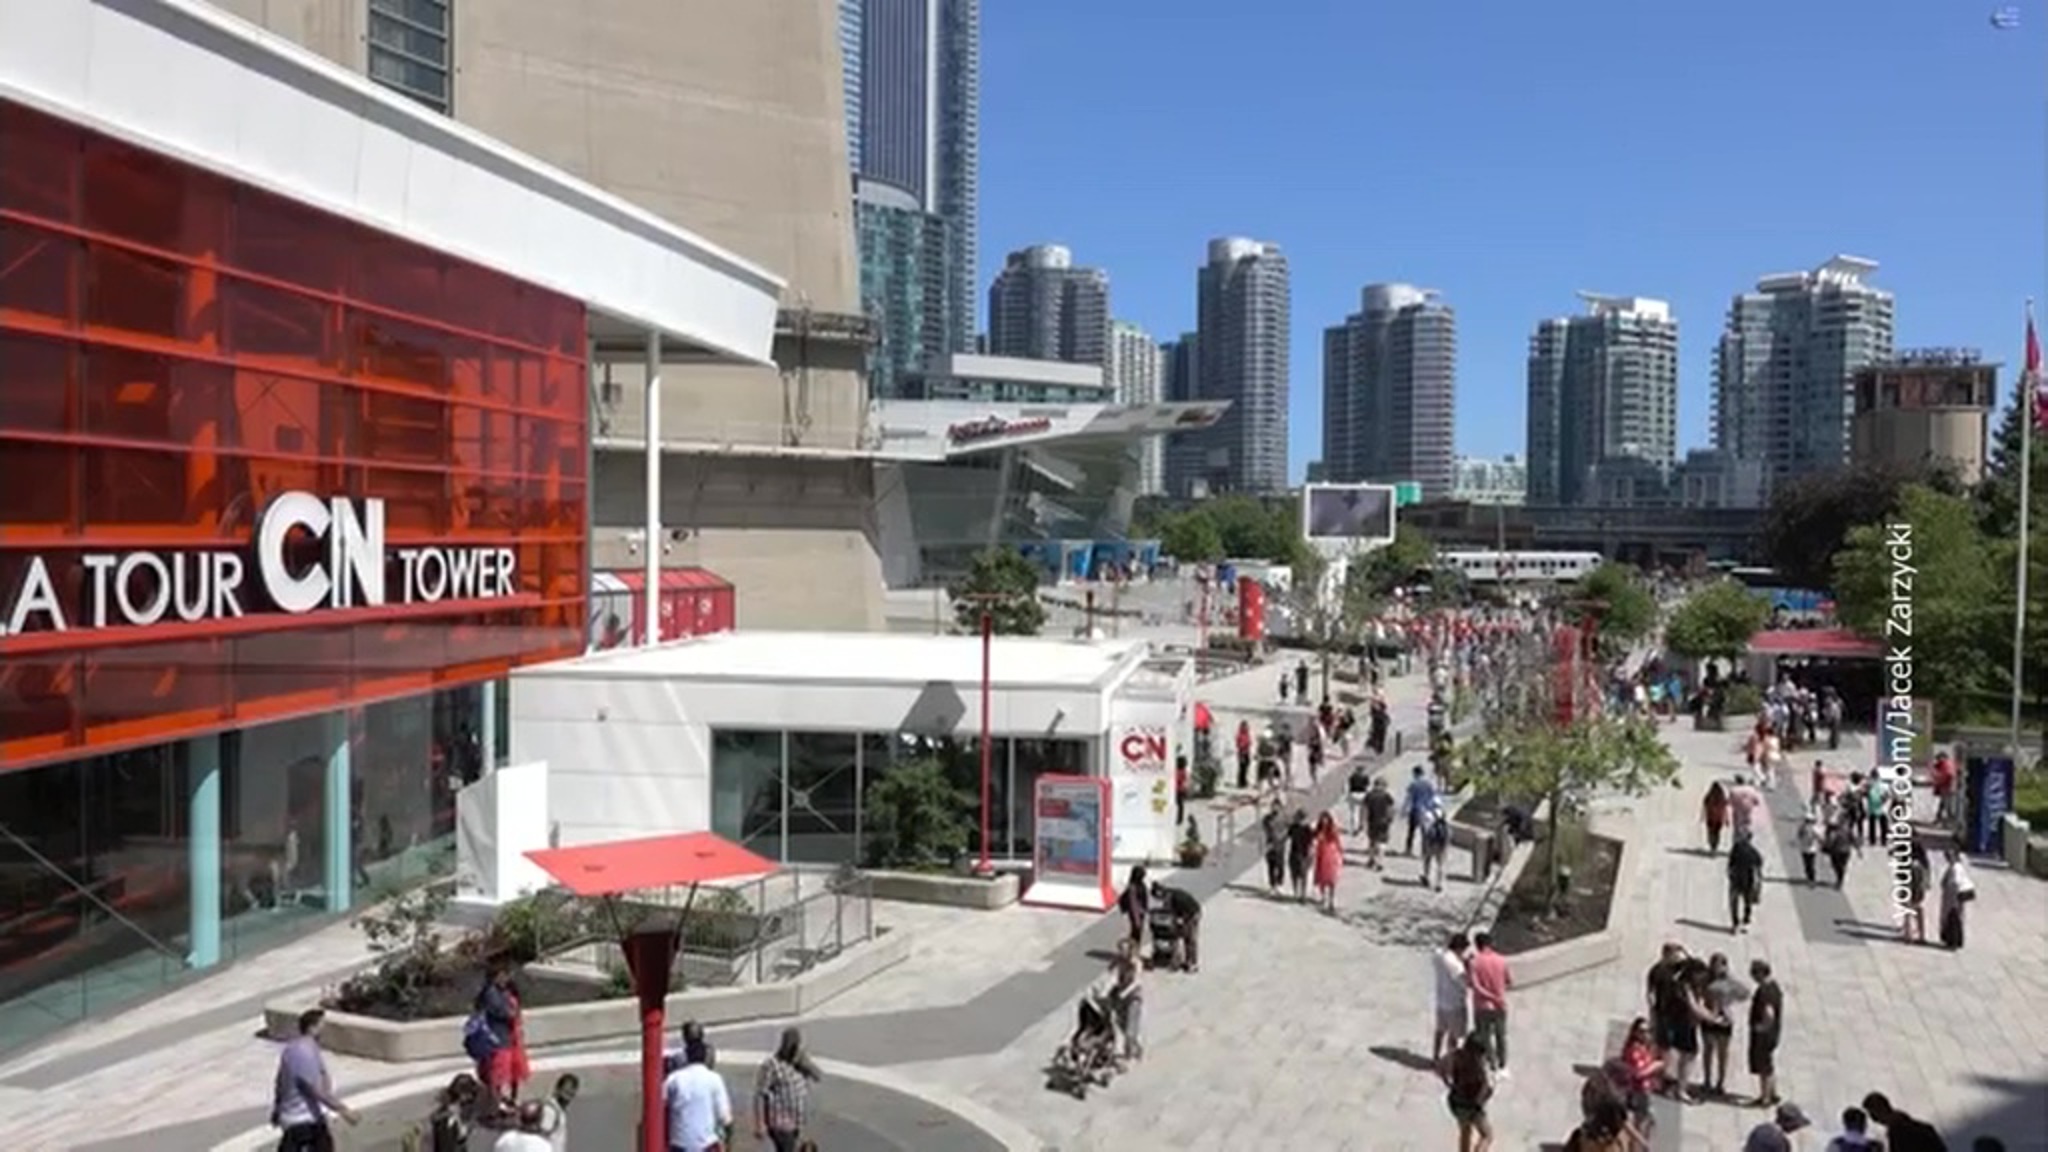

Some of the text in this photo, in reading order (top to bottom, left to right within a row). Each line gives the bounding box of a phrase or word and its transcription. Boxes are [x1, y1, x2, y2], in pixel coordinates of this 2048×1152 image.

[0, 491, 515, 637] A TOUR CN TOWER
[1121, 735, 1166, 762] CN
